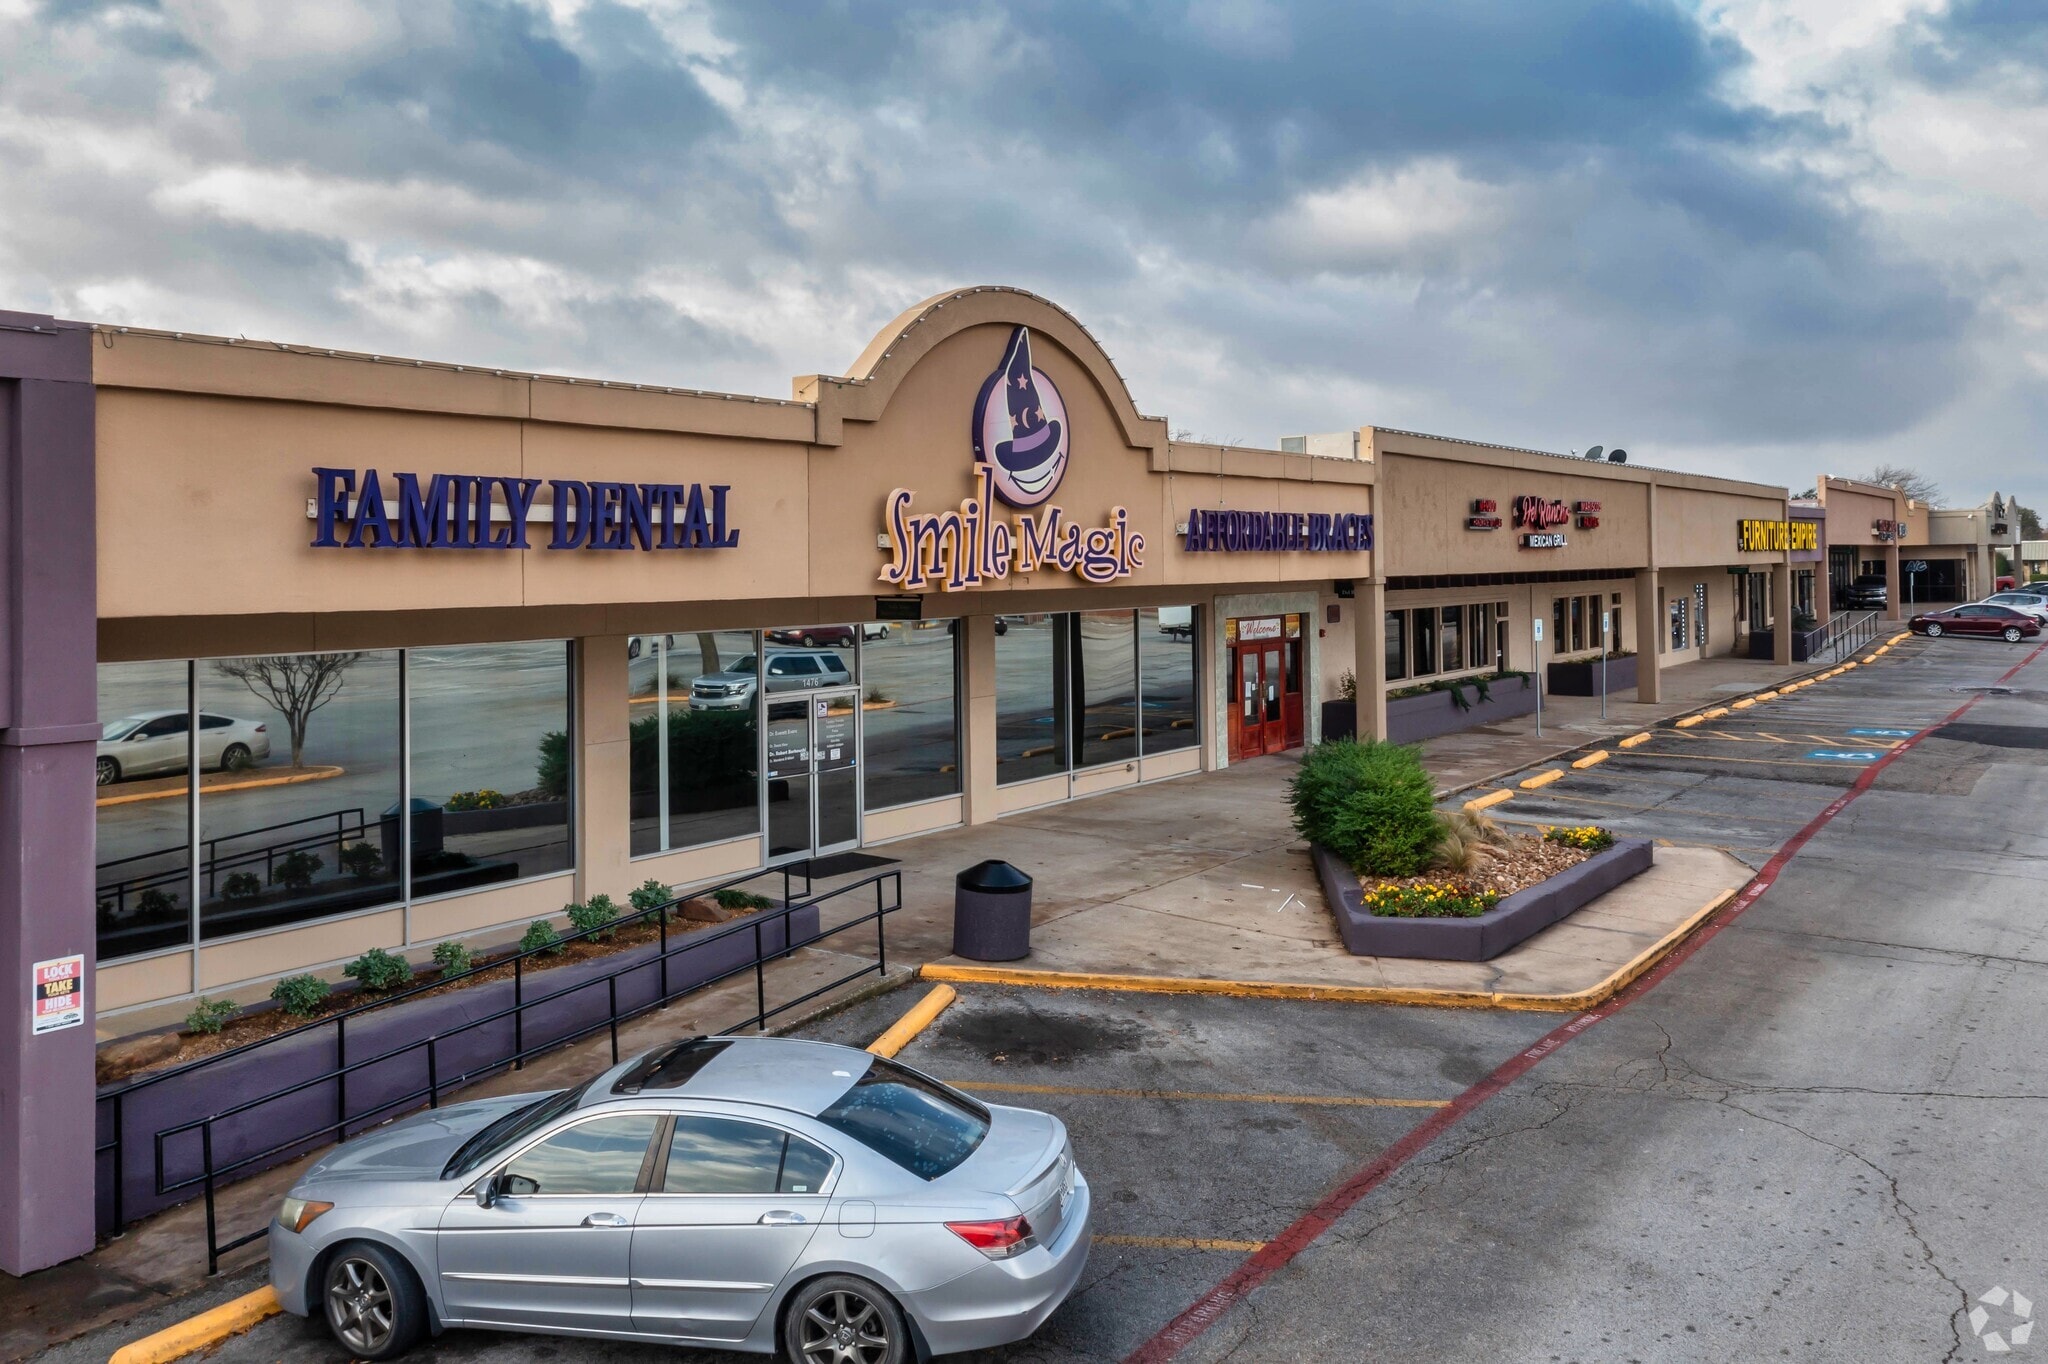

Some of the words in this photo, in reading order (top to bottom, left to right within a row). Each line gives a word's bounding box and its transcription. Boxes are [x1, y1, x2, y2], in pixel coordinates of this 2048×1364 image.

[310, 467, 542, 549] FAMILY
[547, 479, 740, 551] DENTAL
[877, 462, 1011, 592] Smile
[1013, 504, 1145, 583] Magic
[1185, 508, 1305, 551] AFFORDABLE
[1307, 512, 1375, 551] BRACES
[1742, 519, 1789, 551] FURNITURE
[1791, 522, 1818, 550] EMPIRE
[1529, 534, 1553, 547] MEXICAN
[1553, 534, 1568, 547] GRILL
[1245, 620, 1277, 635] Welcome
[802, 678, 819, 687] 1476
[44, 963, 73, 979] LOCK
[44, 979, 73, 995] TAKE
[45, 994, 73, 1010] HIDE
